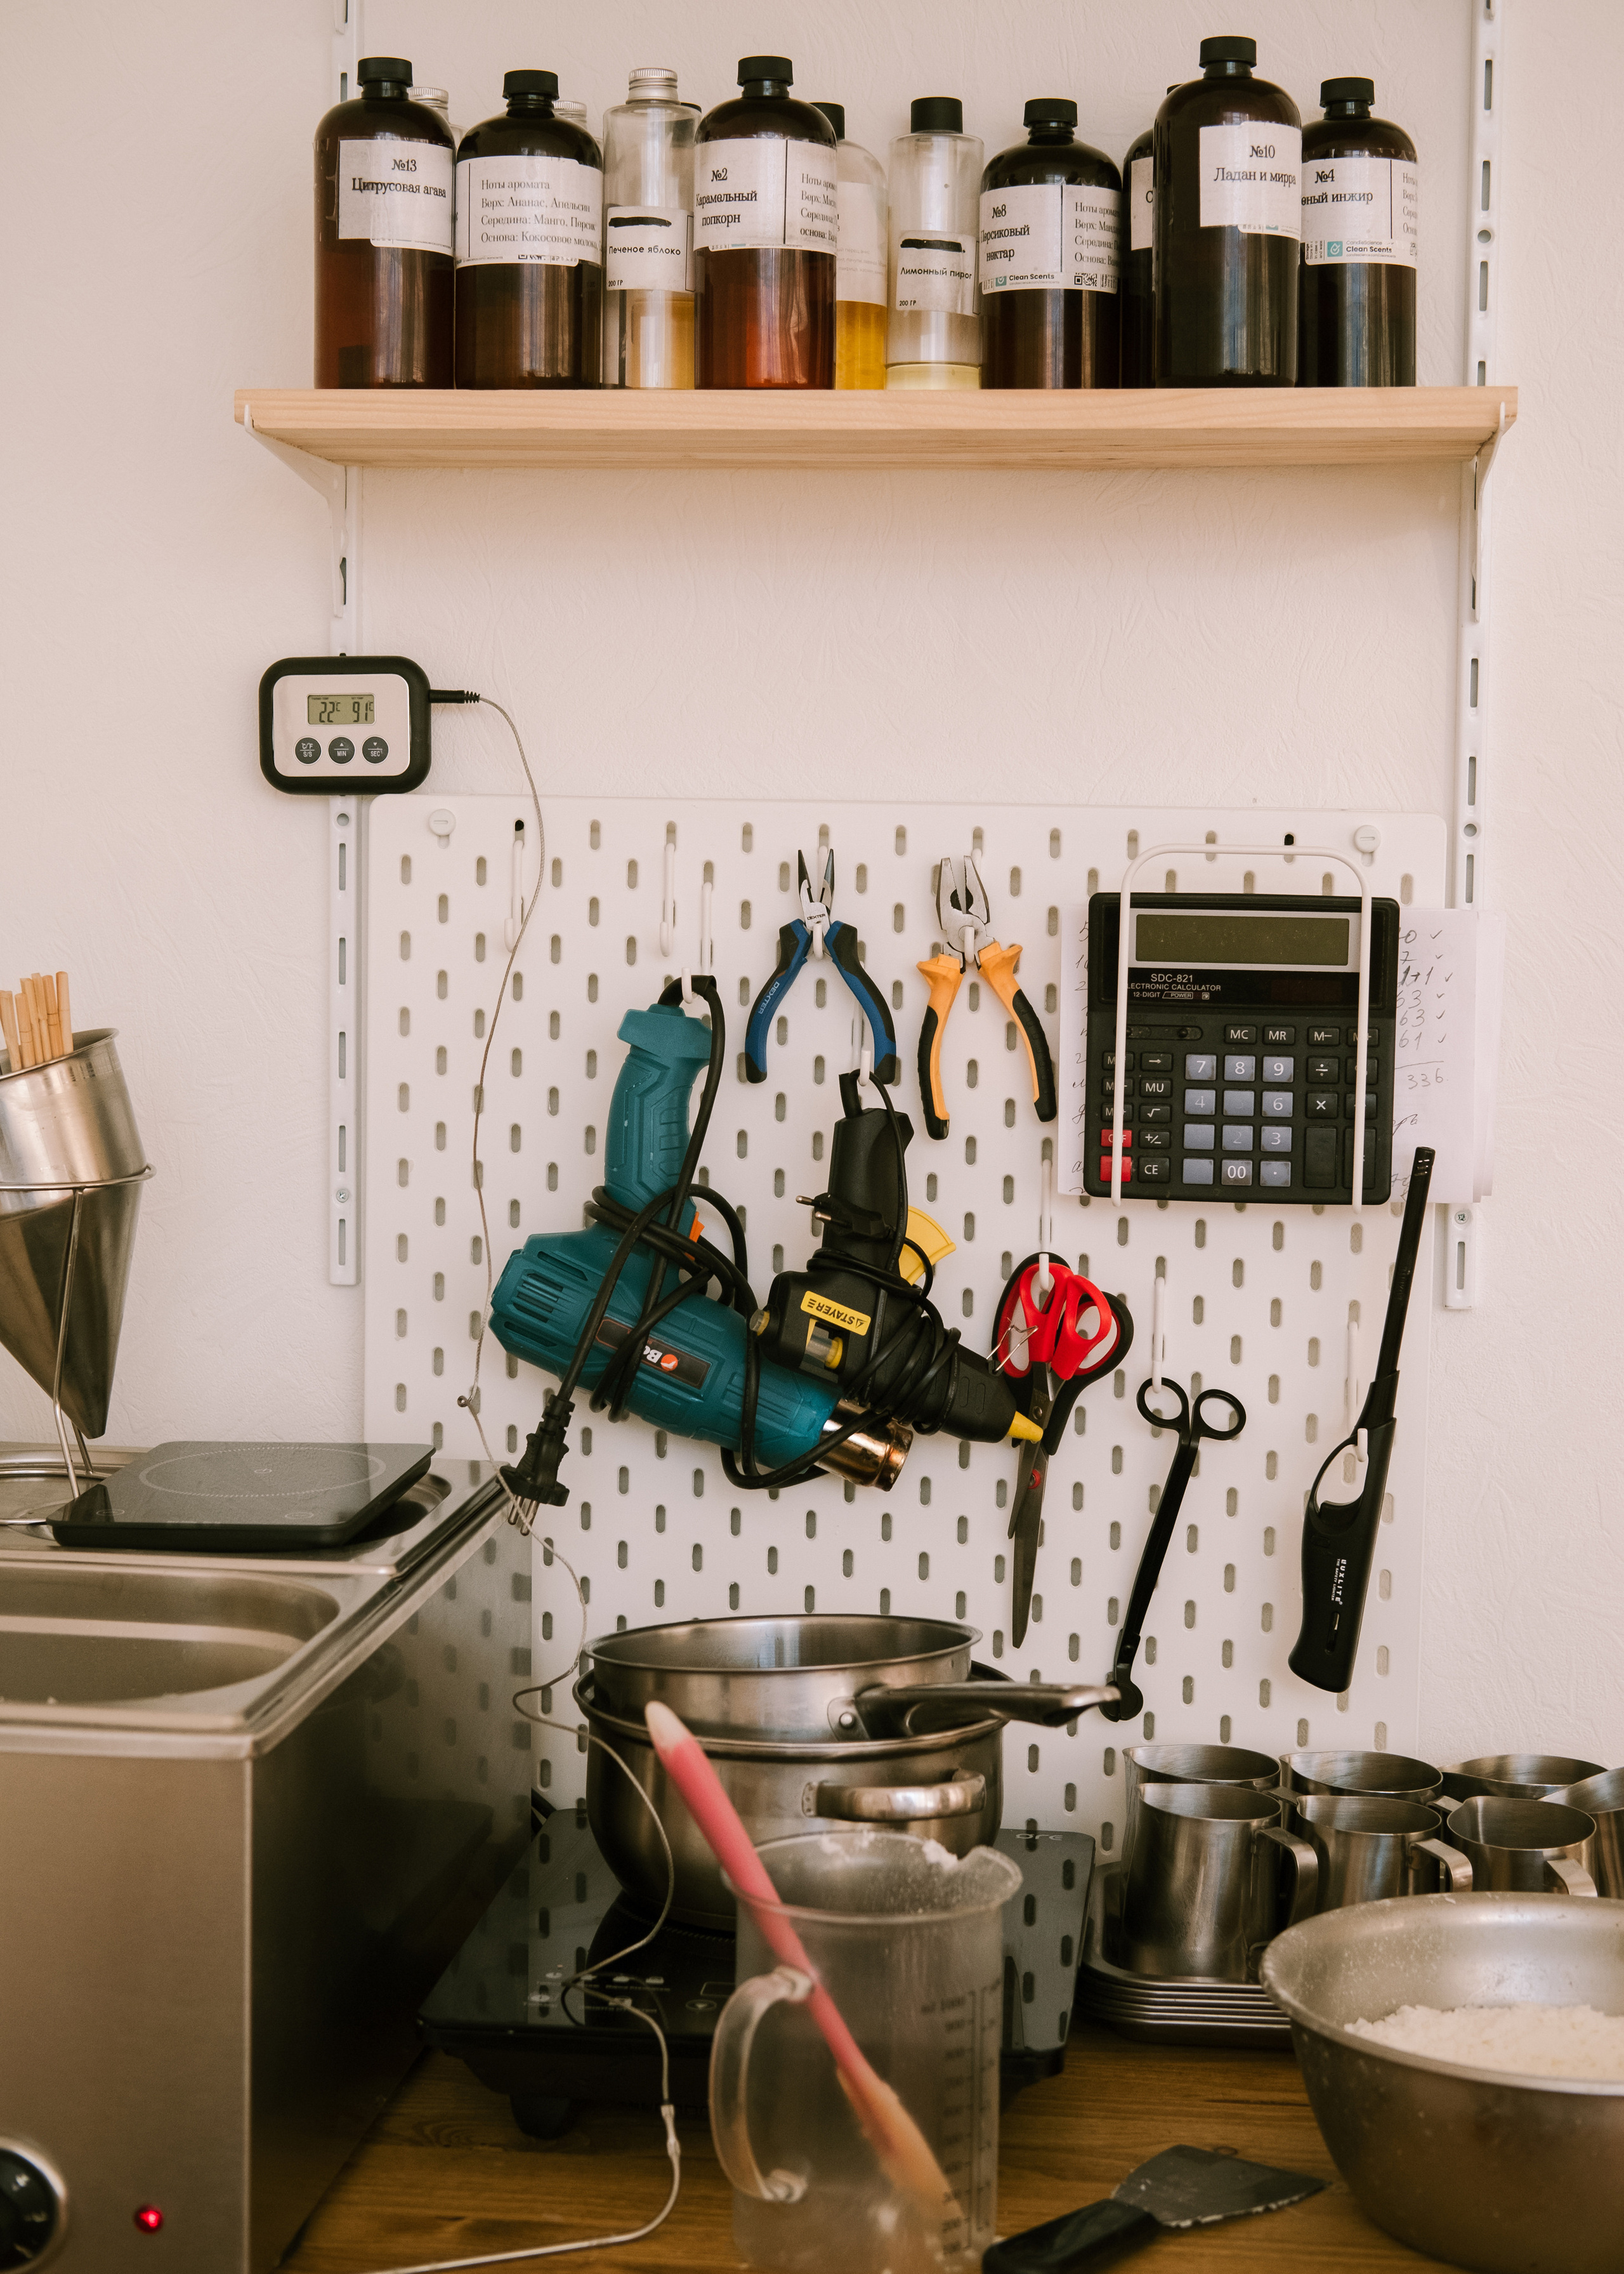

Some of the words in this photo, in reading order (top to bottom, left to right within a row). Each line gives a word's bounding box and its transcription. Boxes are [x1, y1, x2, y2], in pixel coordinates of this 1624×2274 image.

[1249, 145, 1275, 158] №10
[391, 159, 417, 171] №13
[711, 168, 728, 181] №2
[802, 173, 822, 186] Ноты
[1214, 167, 1256, 182] Ладан
[1259, 171, 1267, 181] и
[1269, 171, 1297, 188] мирра
[1314, 169, 1335, 183] №4
[351, 178, 420, 195] Цитрусовая
[424, 185, 446, 197] агава
[481, 180, 505, 190] Ноты
[508, 181, 550, 192] аромата
[696, 190, 757, 209] Карамельный
[801, 190, 821, 204] Верх:
[1301, 192, 1328, 206] еный
[1332, 192, 1373, 205] инжир
[481, 199, 504, 210] Верх:
[551, 198, 591, 212] Апельсин
[992, 204, 1007, 218] №8
[1075, 202, 1097, 213] Ноты
[481, 215, 530, 227] Середина:
[570, 217, 596, 231] Персик
[702, 214, 741, 227] попкорн
[1075, 218, 1097, 232] Верх:
[481, 232, 518, 243] Основа:
[521, 232, 572, 244] Кокосовое
[800, 228, 827, 239] основа:
[981, 225, 1030, 243] Персиковый
[609, 246, 645, 254] Печеное
[647, 245, 681, 255] яблоко
[986, 248, 1014, 261] нектар
[1075, 251, 1106, 265] Основа:
[900, 267, 947, 276] Лимонный
[950, 270, 972, 280] пирог
[1151, 973, 1193, 983] SDC-821
[758, 982, 780, 1014] DEXTER
[1230, 1030, 1248, 1039] MC
[1269, 1030, 1287, 1041] MR
[1196, 1060, 1206, 1073] 7
[1234, 1061, 1245, 1074] 8
[1273, 1063, 1284, 1075] 9
[1146, 1082, 1164, 1093] MU
[1195, 1096, 1205, 1108] 4
[1273, 1098, 1283, 1110] 6
[1271, 1133, 1281, 1145] 3
[1144, 1164, 1158, 1174] CE
[1228, 1166, 1246, 1179] 00
[816, 1302, 855, 1324] STAYER
